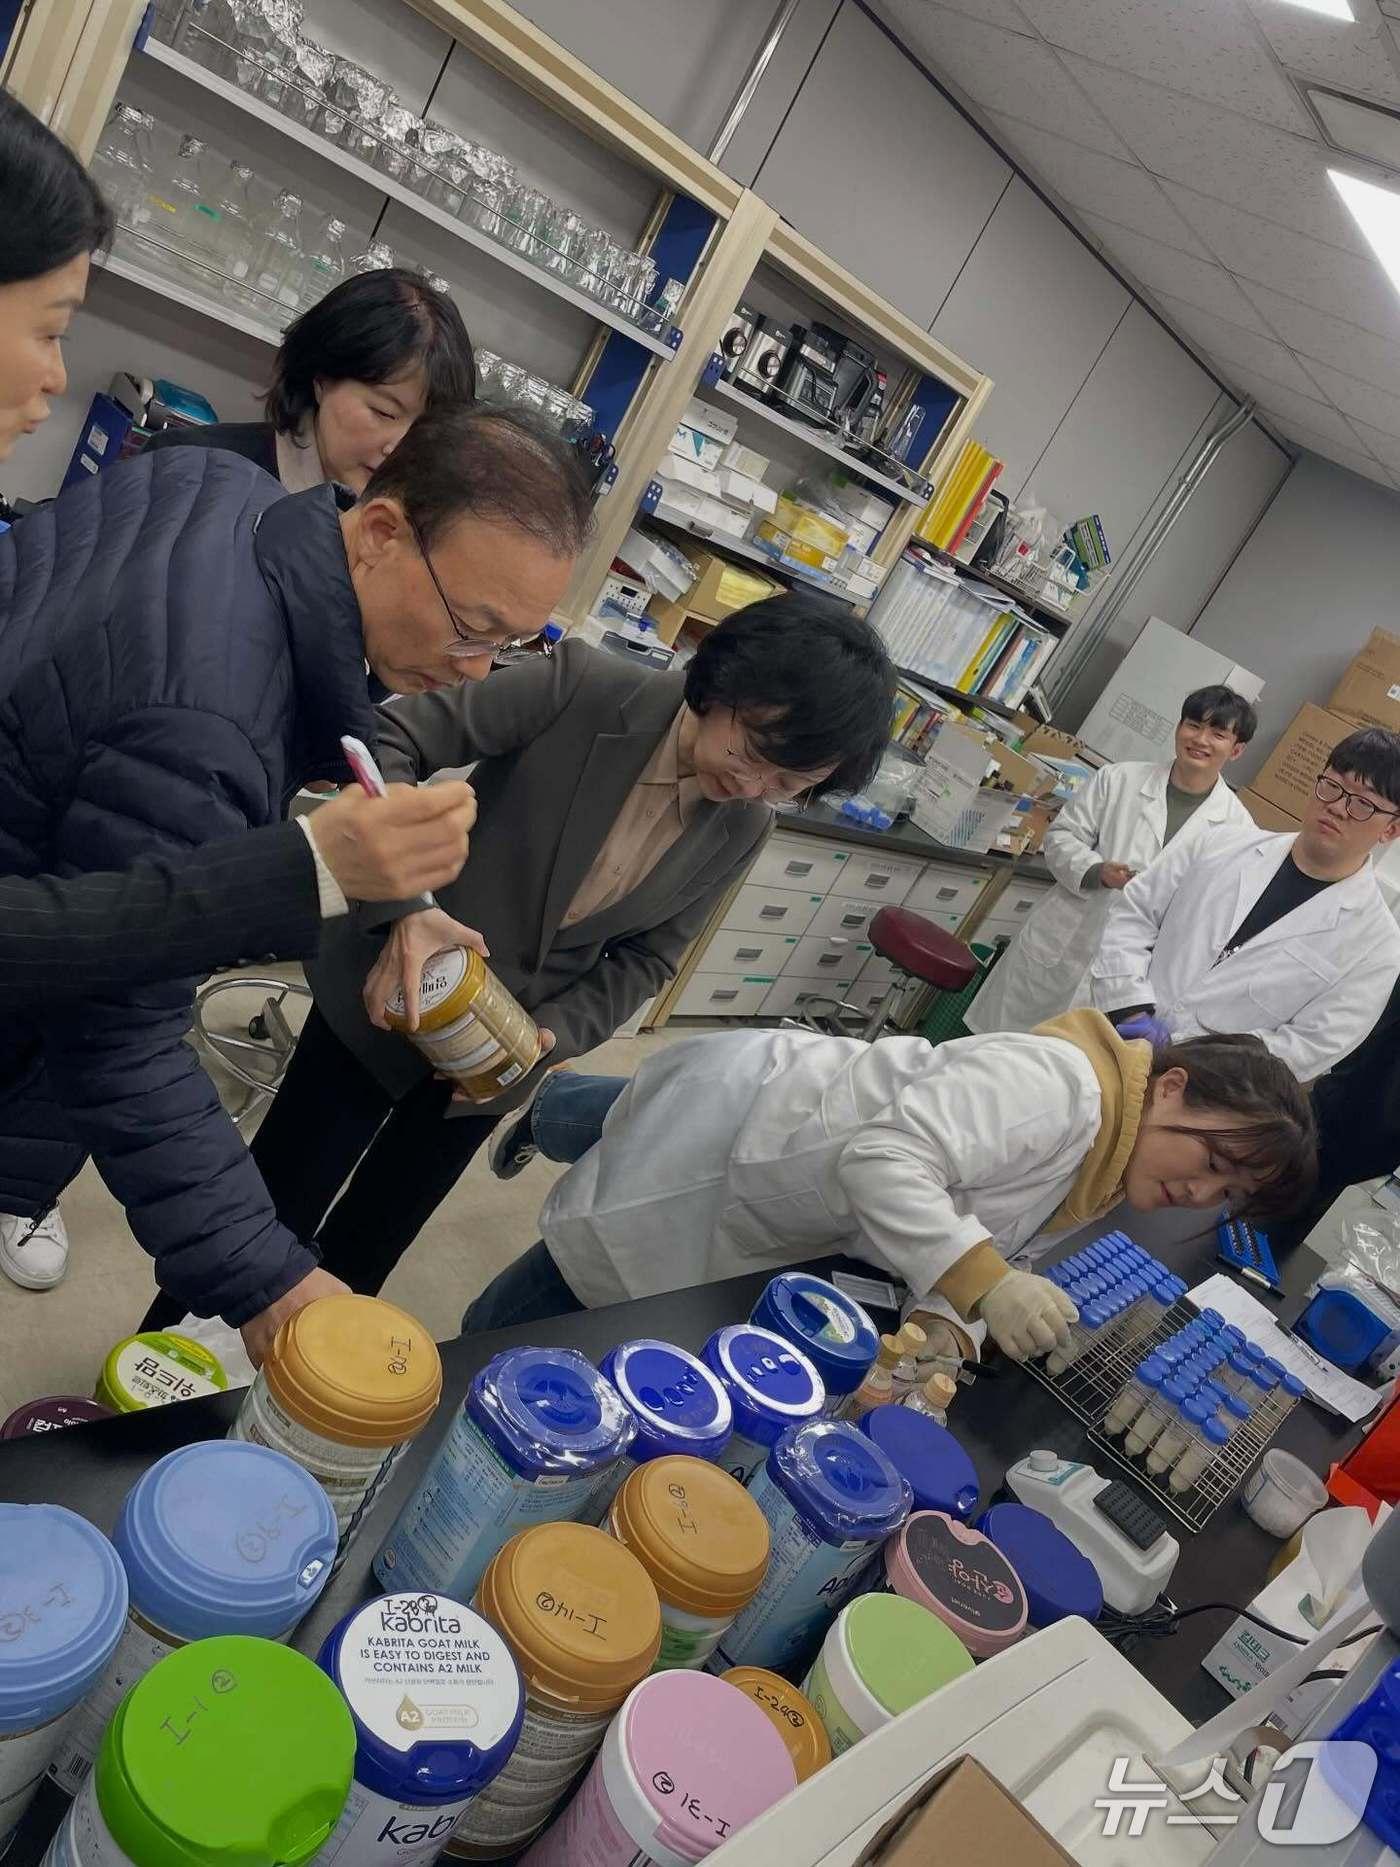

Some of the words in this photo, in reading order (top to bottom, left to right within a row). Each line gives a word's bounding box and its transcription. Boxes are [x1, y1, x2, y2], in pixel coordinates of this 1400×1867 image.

[135, 1357, 196, 1397] 위드맘
[381, 1612, 461, 1634] kabrita
[367, 1637, 415, 1648] KABRITA
[418, 1638, 450, 1649] GOAT
[454, 1639, 480, 1649] MILK
[360, 1649, 370, 1659] IS
[373, 1650, 400, 1660] EASY
[404, 1651, 420, 1661] TO
[424, 1651, 462, 1661] DIGEST
[465, 1652, 490, 1661] AND
[373, 1662, 434, 1673] CONTAINS
[438, 1663, 453, 1673] A2
[456, 1664, 482, 1673] MILK
[400, 1710, 422, 1723] A2
